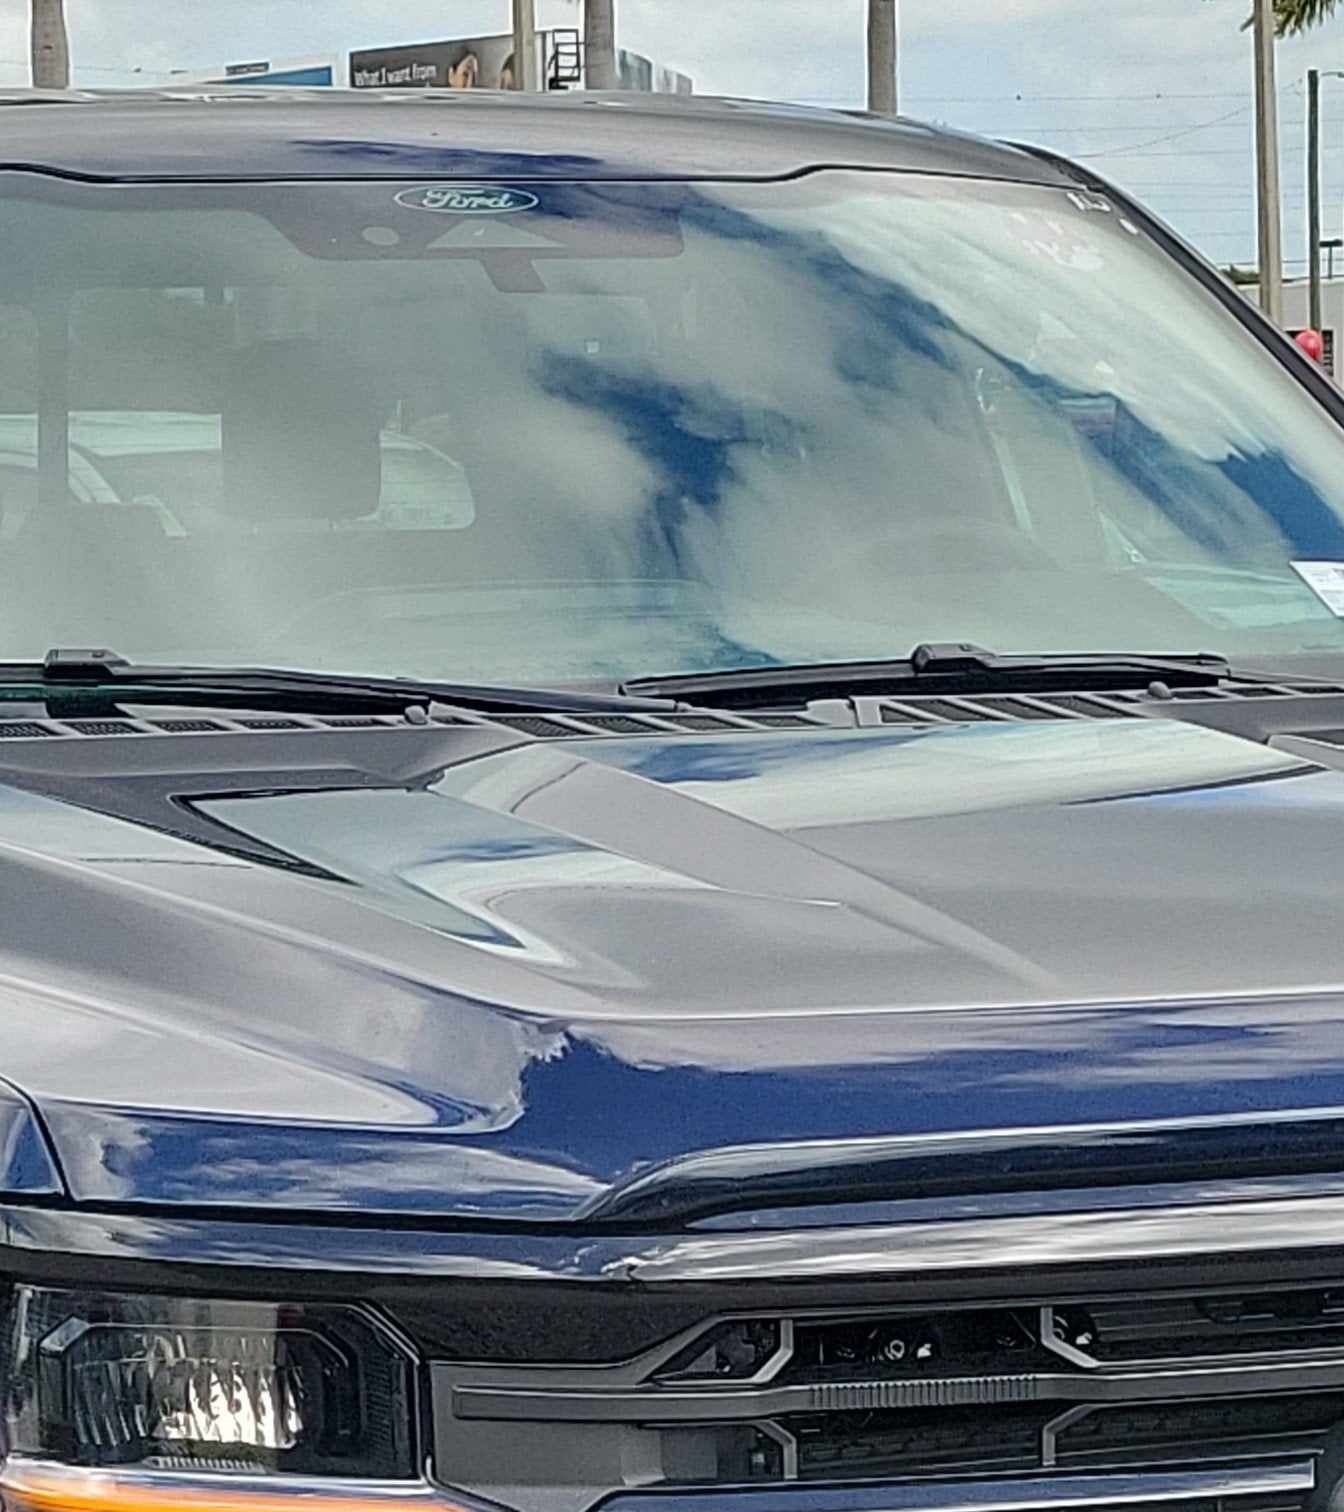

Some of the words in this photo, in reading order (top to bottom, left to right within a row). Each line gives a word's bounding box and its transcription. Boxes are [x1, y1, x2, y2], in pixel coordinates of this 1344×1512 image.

[354, 70, 380, 87] What
[387, 65, 412, 82] want
[412, 62, 437, 80] from
[422, 188, 513, 209] Ford
